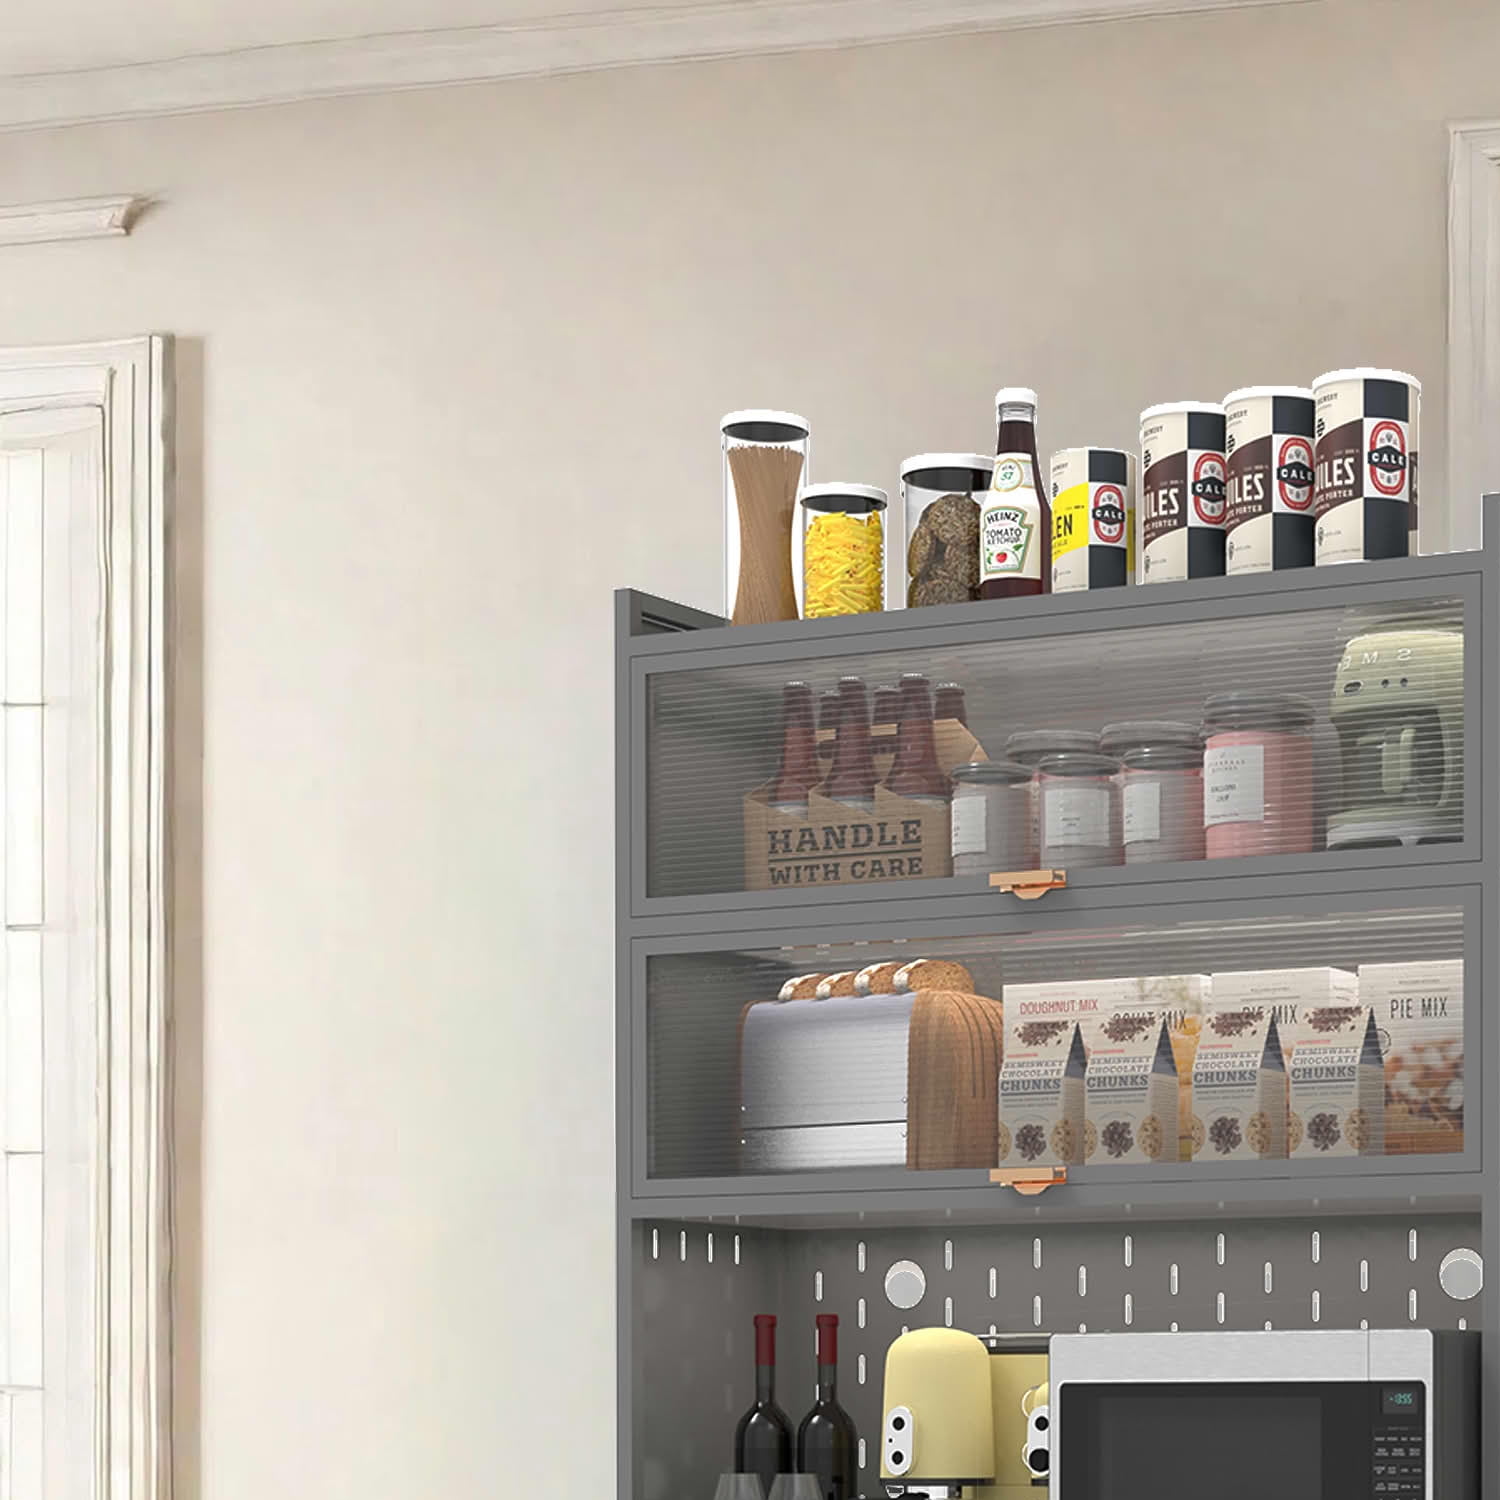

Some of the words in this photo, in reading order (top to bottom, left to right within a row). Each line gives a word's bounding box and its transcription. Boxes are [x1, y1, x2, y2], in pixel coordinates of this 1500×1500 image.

[987, 511, 1019, 524] HEINZ
[986, 527, 1022, 538] TOMATO
[768, 819, 922, 854] HANDLE
[769, 862, 841, 885] WITH
[850, 857, 923, 880] CARE
[1020, 1000, 1076, 1015] DOUGHNUT
[1078, 999, 1099, 1012] MIX
[1390, 998, 1413, 1019] PIE
[1422, 996, 1448, 1017] MIX
[1272, 1004, 1298, 1025] MIX
[1195, 1060, 1258, 1070] CHOCOLATE
[1293, 1056, 1357, 1065] CHOCOLATE
[1002, 1068, 1063, 1079] CHOCOLATE
[1088, 1065, 1150, 1075] CHOCOLATE
[1194, 1070, 1257, 1083] CHUNKS
[1291, 1065, 1356, 1080] CHUNKS
[1001, 1079, 1061, 1092] CHUNKS
[1087, 1075, 1148, 1088] CHUNKS
